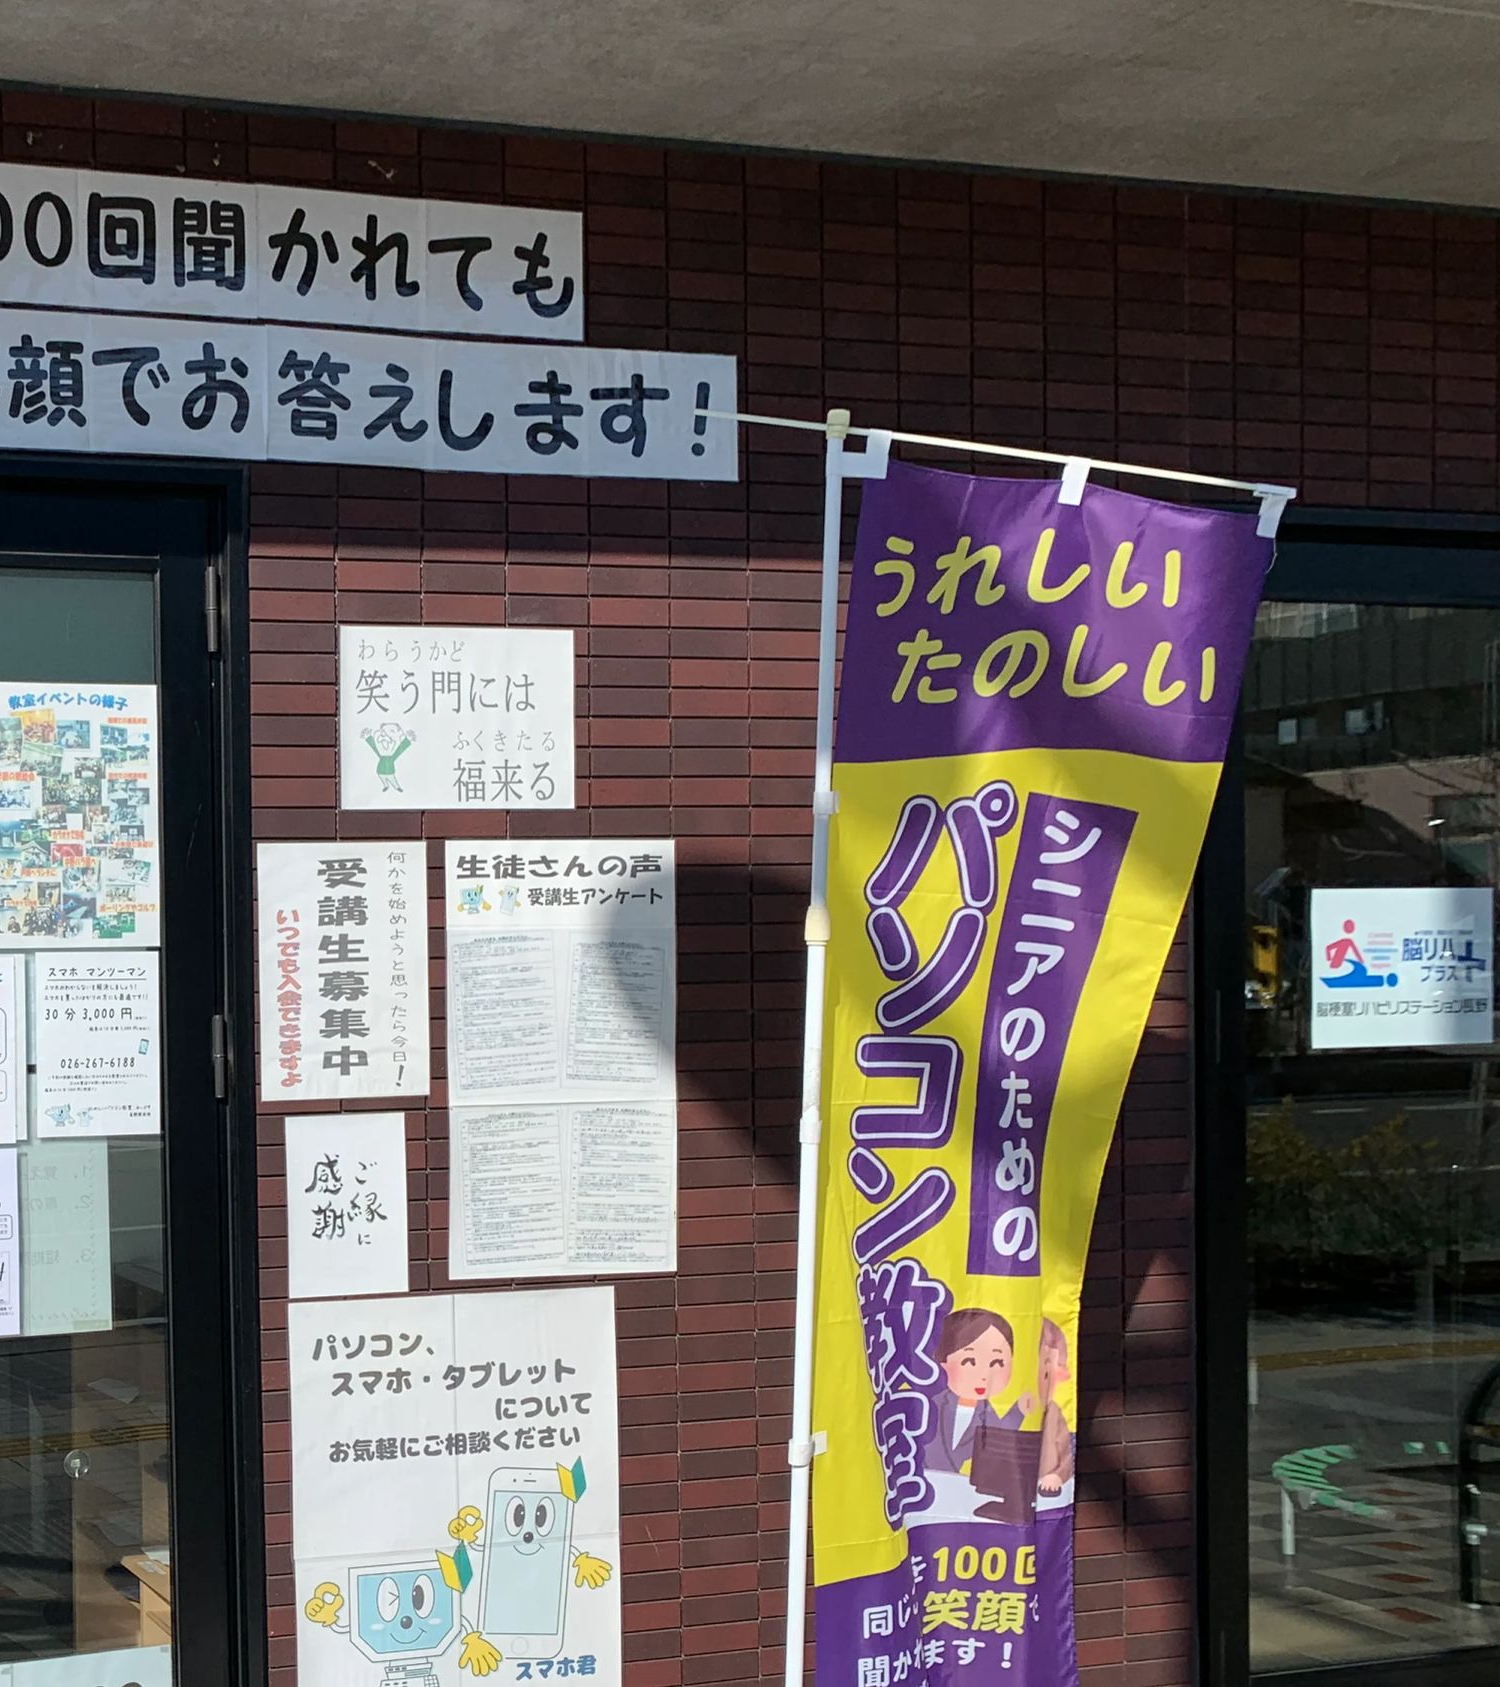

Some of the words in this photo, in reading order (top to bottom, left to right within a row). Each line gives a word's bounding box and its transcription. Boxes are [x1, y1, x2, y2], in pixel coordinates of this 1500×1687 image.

[874, 528, 1181, 617] うれしい
[358, 638, 466, 662] わらうかど
[891, 624, 1216, 707] たのしい
[355, 669, 536, 715] 笑う門には
[453, 729, 556, 752] ふくきたる
[453, 758, 556, 802] 福来る
[456, 854, 663, 880] 生徒さんの声
[527, 888, 663, 906] 受講生アンケート
[317, 857, 370, 1076] 受講生募集中
[277, 910, 303, 1088] いつでも入会できますよ
[992, 810, 1102, 1262] シニアのための
[60, 1057, 136, 1070] 026-267-6188
[305, 1153, 345, 1241] 感謝
[331, 1358, 576, 1397] スマホ・タブレット
[495, 1393, 592, 1421] について
[329, 1425, 580, 1463] お気軽にご相談ください
[515, 1654, 597, 1681] スマホ君
